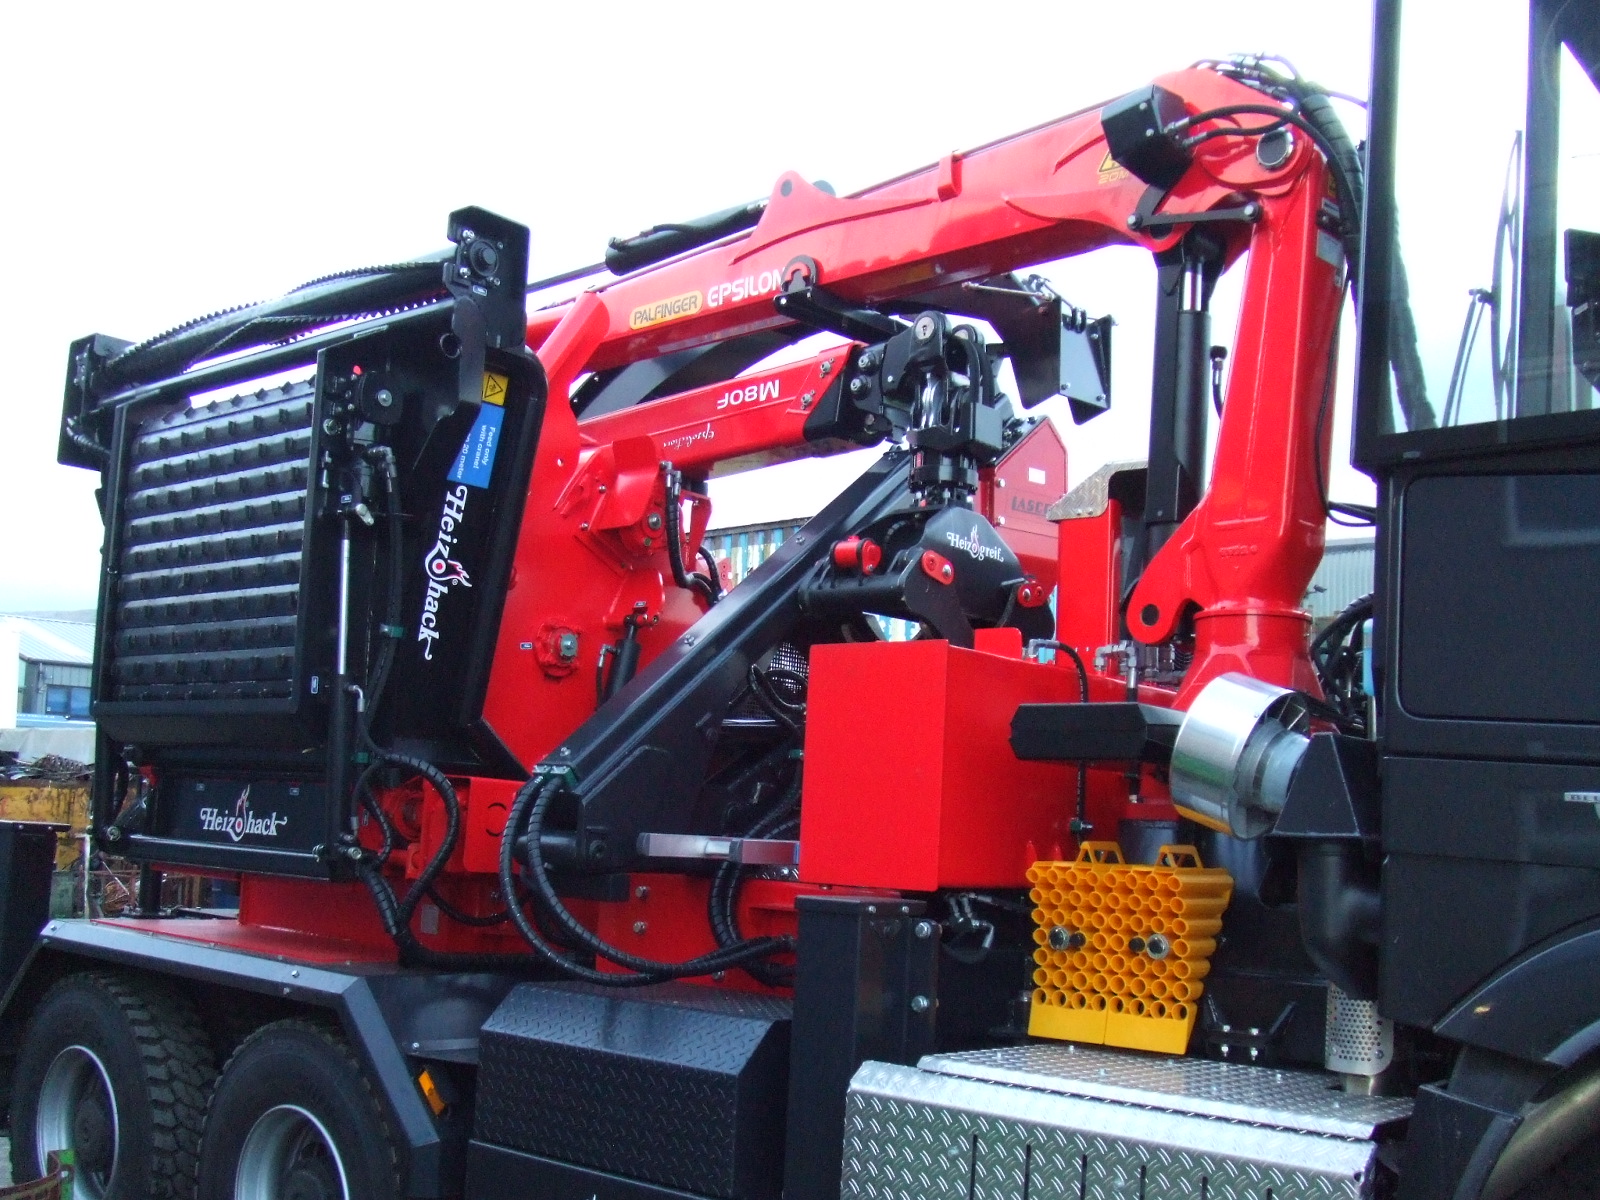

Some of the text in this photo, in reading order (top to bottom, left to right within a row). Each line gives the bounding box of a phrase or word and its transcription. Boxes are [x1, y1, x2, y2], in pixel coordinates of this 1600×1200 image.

[633, 268, 784, 325] PALFINGER EPSILON
[716, 379, 780, 410] M80F
[479, 425, 487, 442] with
[482, 427, 496, 466] Feed only
[462, 443, 469, 454] 20
[457, 455, 467, 479] meter
